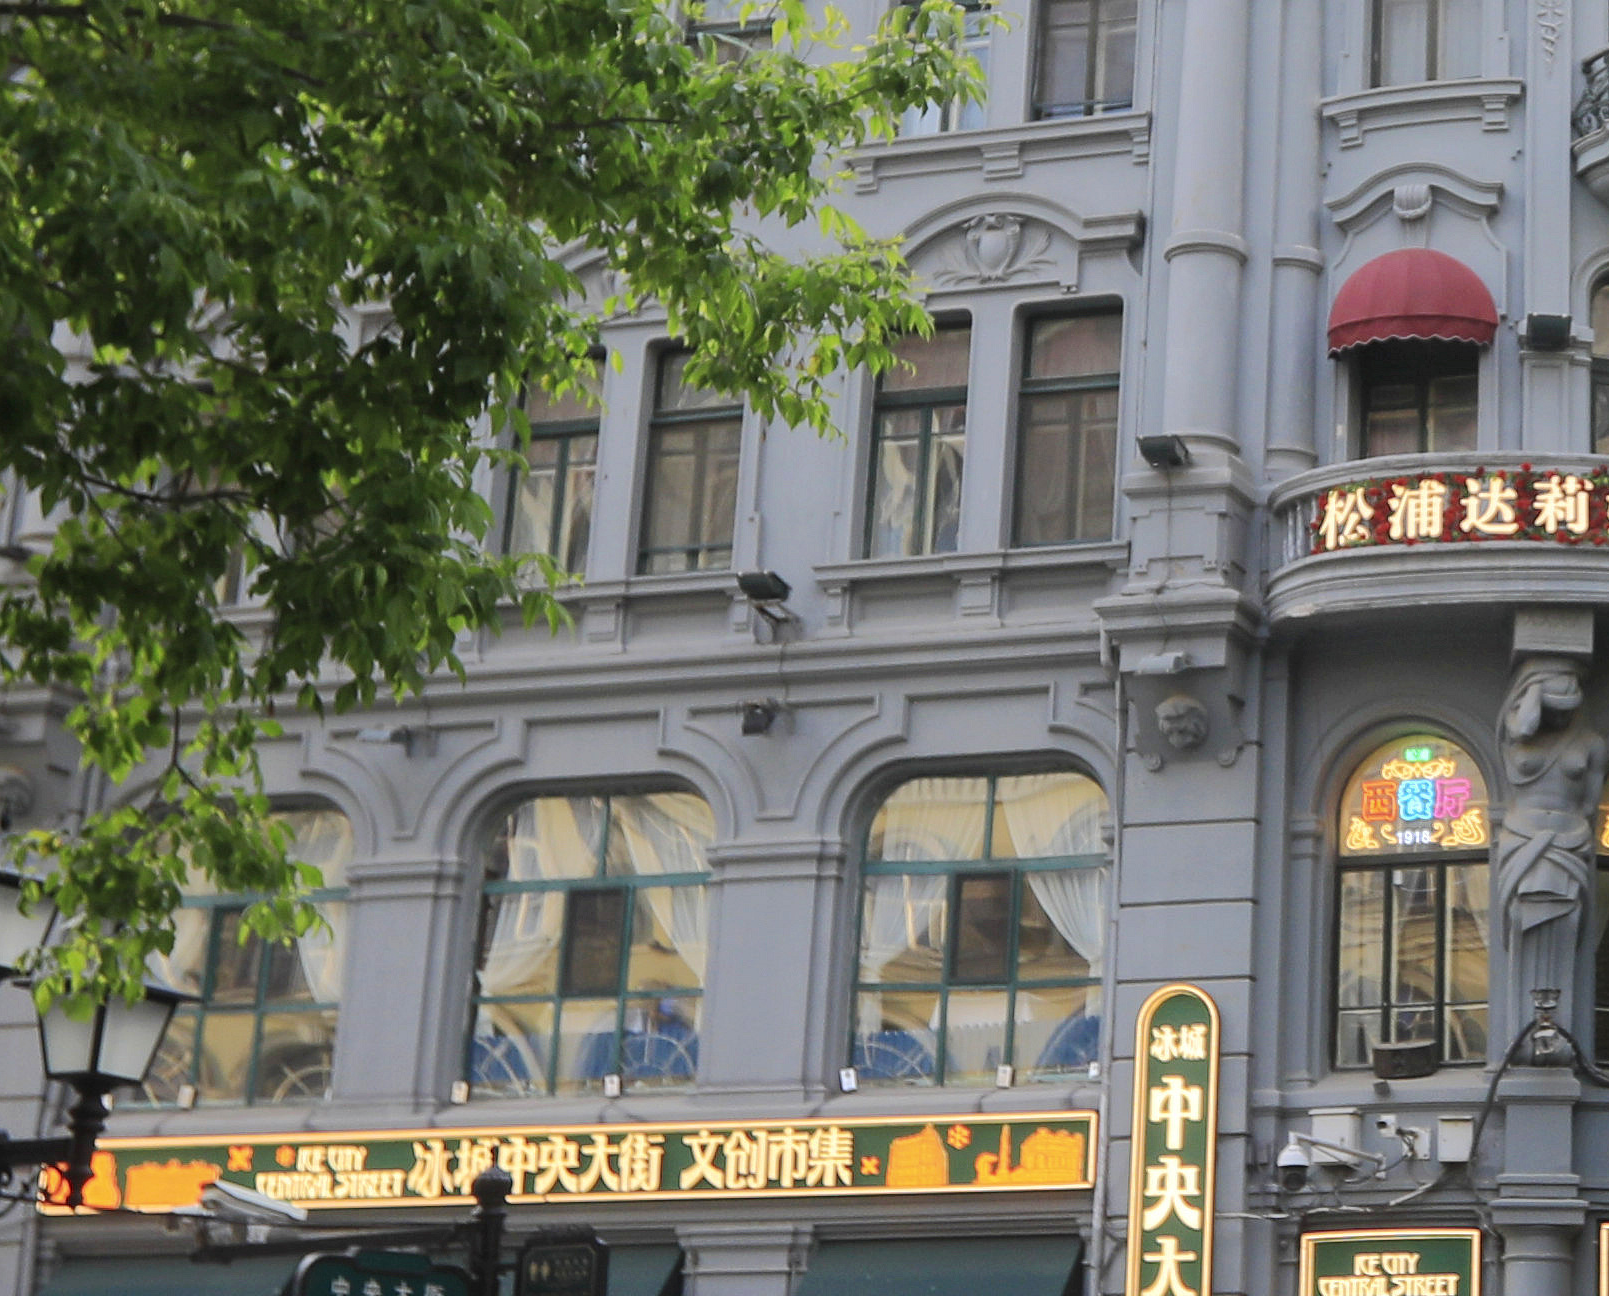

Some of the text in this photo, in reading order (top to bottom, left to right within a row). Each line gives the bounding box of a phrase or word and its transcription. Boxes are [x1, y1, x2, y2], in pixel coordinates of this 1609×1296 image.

[1361, 777, 1471, 822] 西餐厅
[1397, 830, 1432, 844] 1918
[1150, 1023, 1209, 1063] 冰城
[680, 1126, 854, 1190] 文创市集
[1354, 1252, 1421, 1276] ICE CITY
